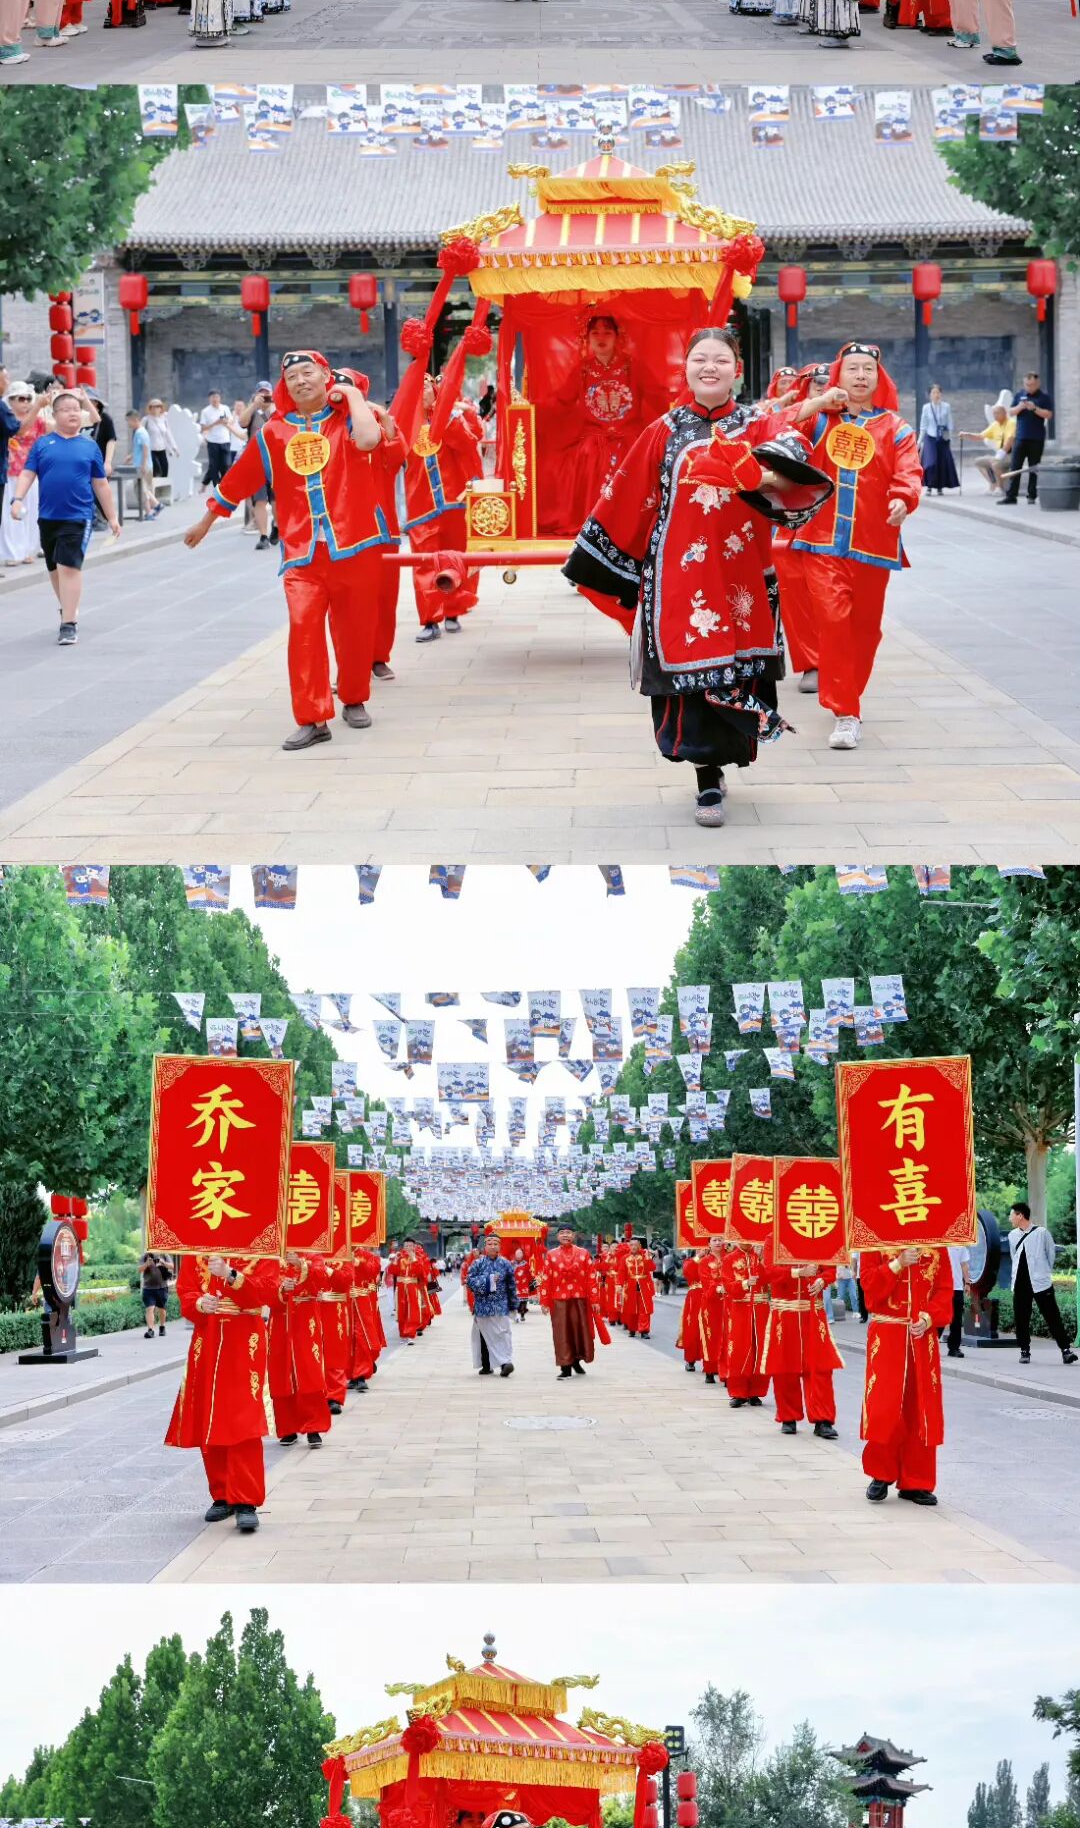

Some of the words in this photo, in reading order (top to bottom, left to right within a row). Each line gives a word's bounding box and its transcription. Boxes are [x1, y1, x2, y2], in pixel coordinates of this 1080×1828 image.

[291, 438, 325, 469] 囍
[831, 429, 869, 464] 囍
[186, 1084, 257, 1230] 乔家
[877, 1083, 942, 1226] 有喜
[786, 1183, 840, 1239] 囍
